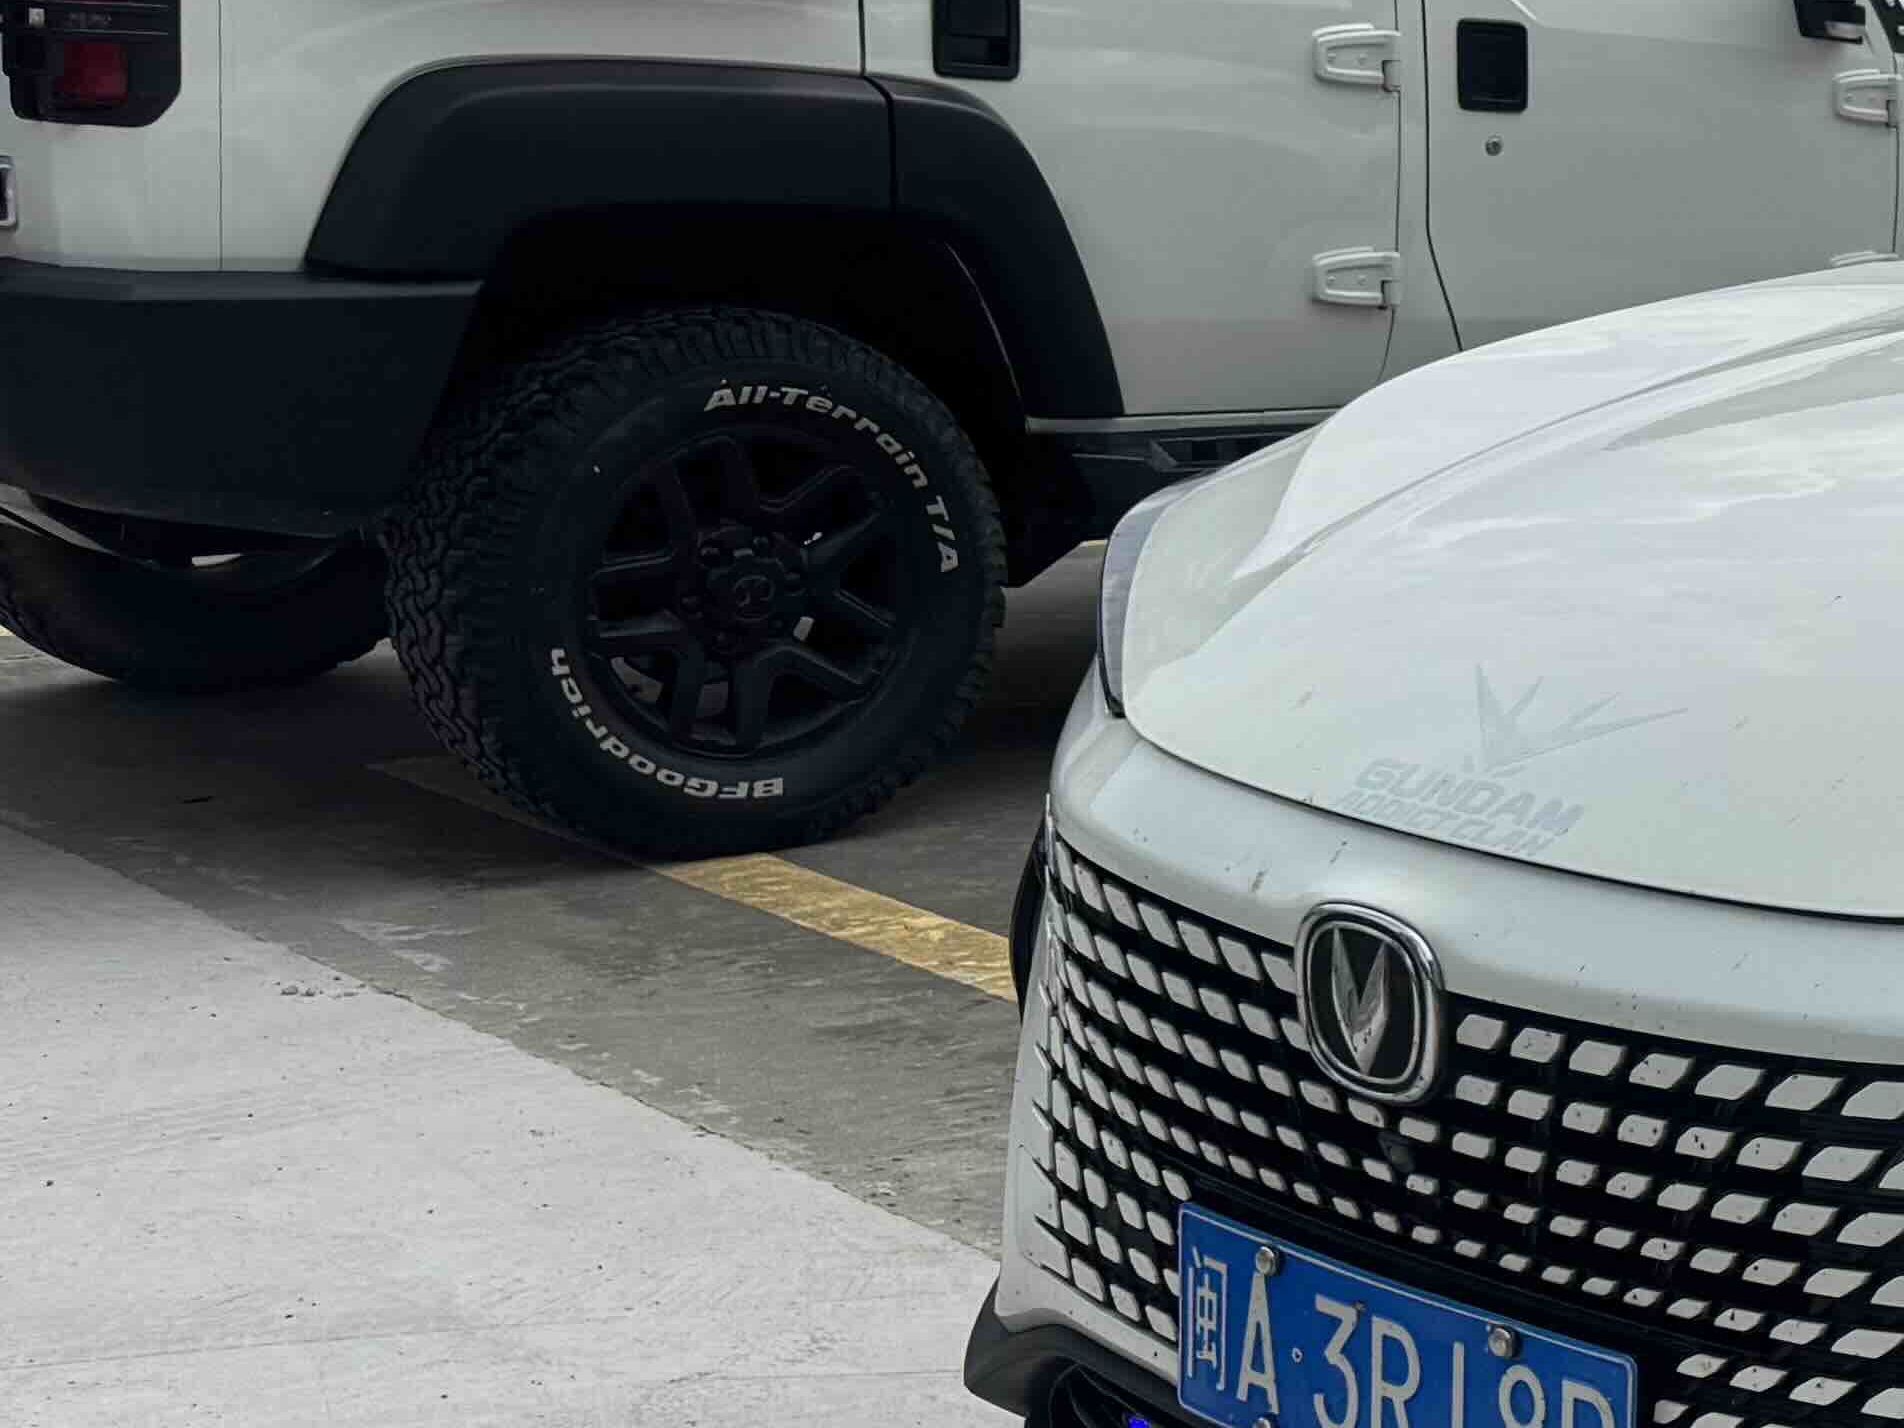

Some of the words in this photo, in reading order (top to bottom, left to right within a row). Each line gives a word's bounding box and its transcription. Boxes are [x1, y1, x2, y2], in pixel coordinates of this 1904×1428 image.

[703, 383, 928, 489] All-Terrain
[925, 494, 958, 574] T/A
[550, 647, 784, 800] BFGoodrich
[1353, 758, 1584, 830] GUNDAM
